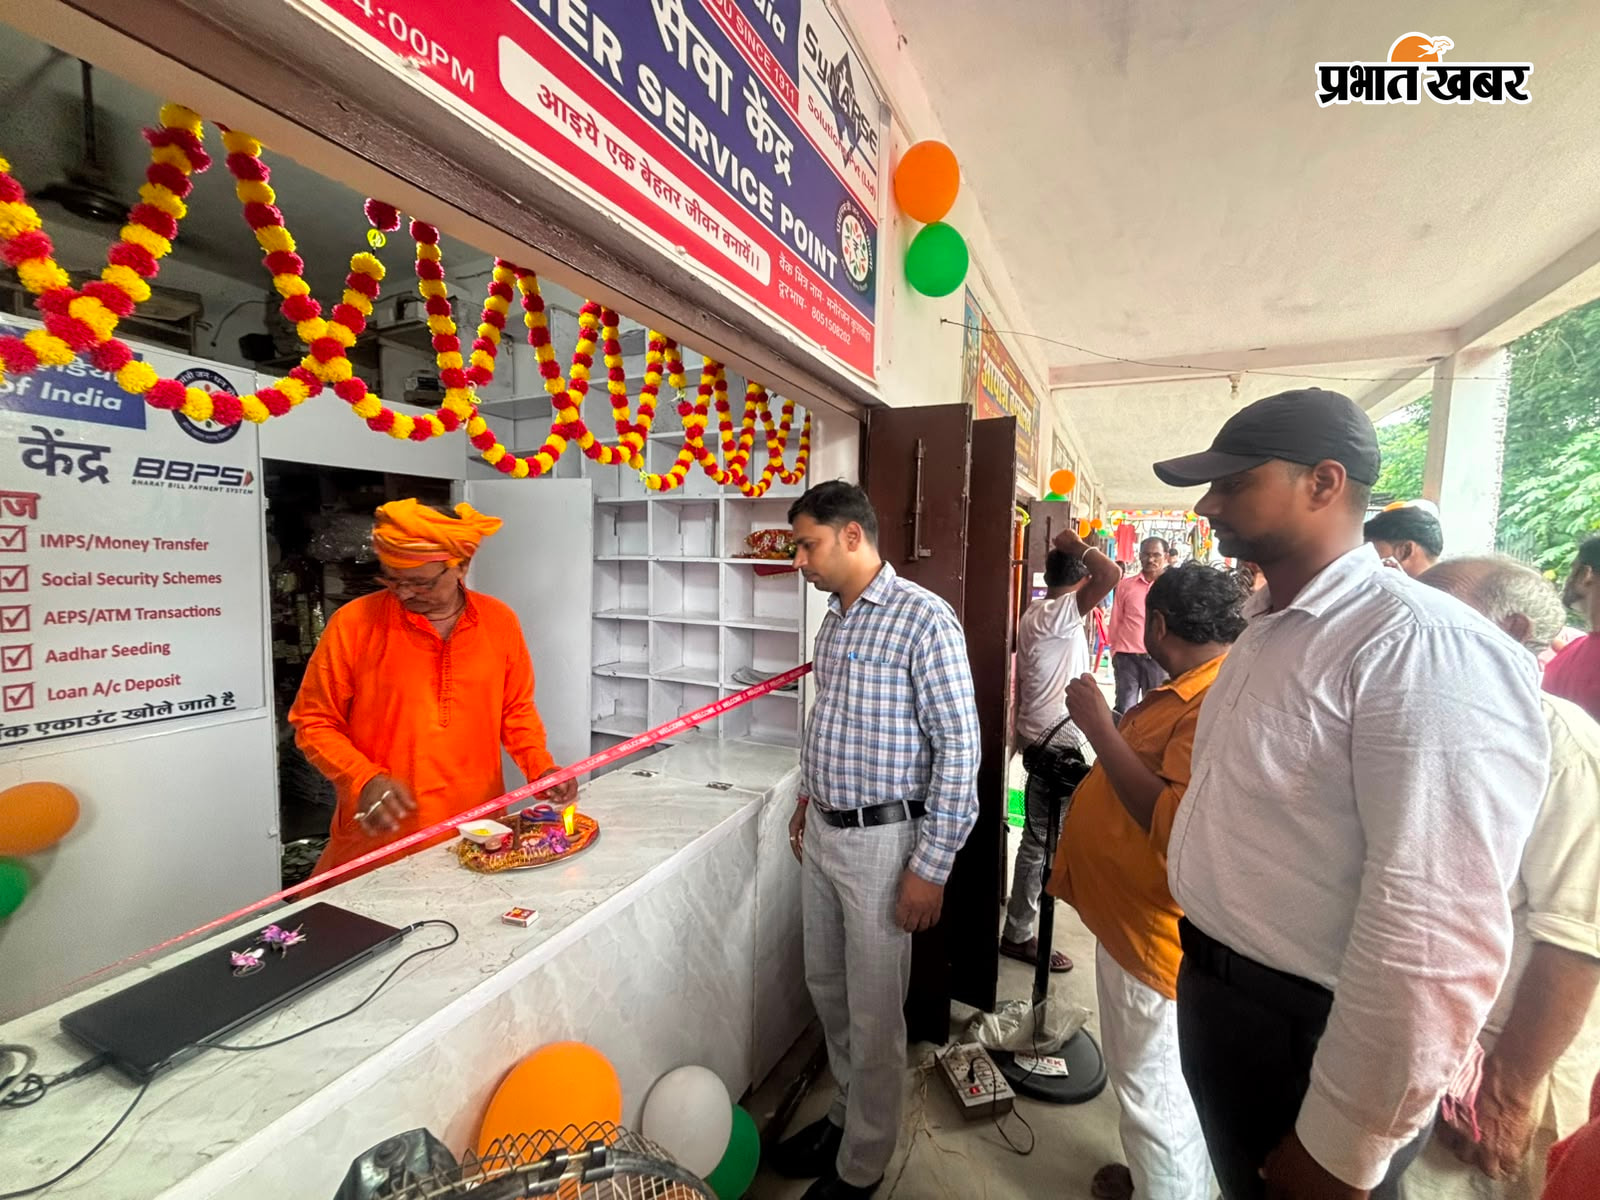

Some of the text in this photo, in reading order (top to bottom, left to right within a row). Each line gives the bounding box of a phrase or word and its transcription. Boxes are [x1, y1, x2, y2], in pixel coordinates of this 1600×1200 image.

[736, 15, 771, 73] SINCE
[774, 68, 794, 103] 1911
[743, 74, 794, 187] केंद्र
[537, 84, 600, 148] आइये
[604, 134, 636, 172] एक
[639, 158, 682, 210] बेहतर
[684, 197, 720, 240] जीवन
[637, 63, 773, 223] SERVICE
[781, 203, 838, 280] POINT
[40, 381, 122, 411] India
[18, 425, 112, 484] केंद्र
[132, 457, 245, 487] BBPS
[132, 479, 253, 495] BHARAT BILL PAYMENT SYSTEM
[40, 534, 209, 552] IMPS/Money Transfer
[41, 571, 222, 588] Social Security Schemes
[43, 605, 222, 626] AEPS/ATM Transactions
[45, 642, 171, 664] Aadhar Seeding
[47, 673, 182, 702] Loan A/c Deposit
[34, 709, 118, 735] एकाउंट
[122, 700, 173, 720] खोले
[178, 694, 218, 712] जाते
[443, 802, 500, 827] WELCOME
[511, 776, 556, 798] WELCOME
[572, 752, 609, 772] WELCOME
[618, 735, 650, 753] WELCOME
[658, 719, 686, 736] WELCOME
[691, 706, 716, 721] WELCOME
[722, 694, 743, 709] WELCOME
